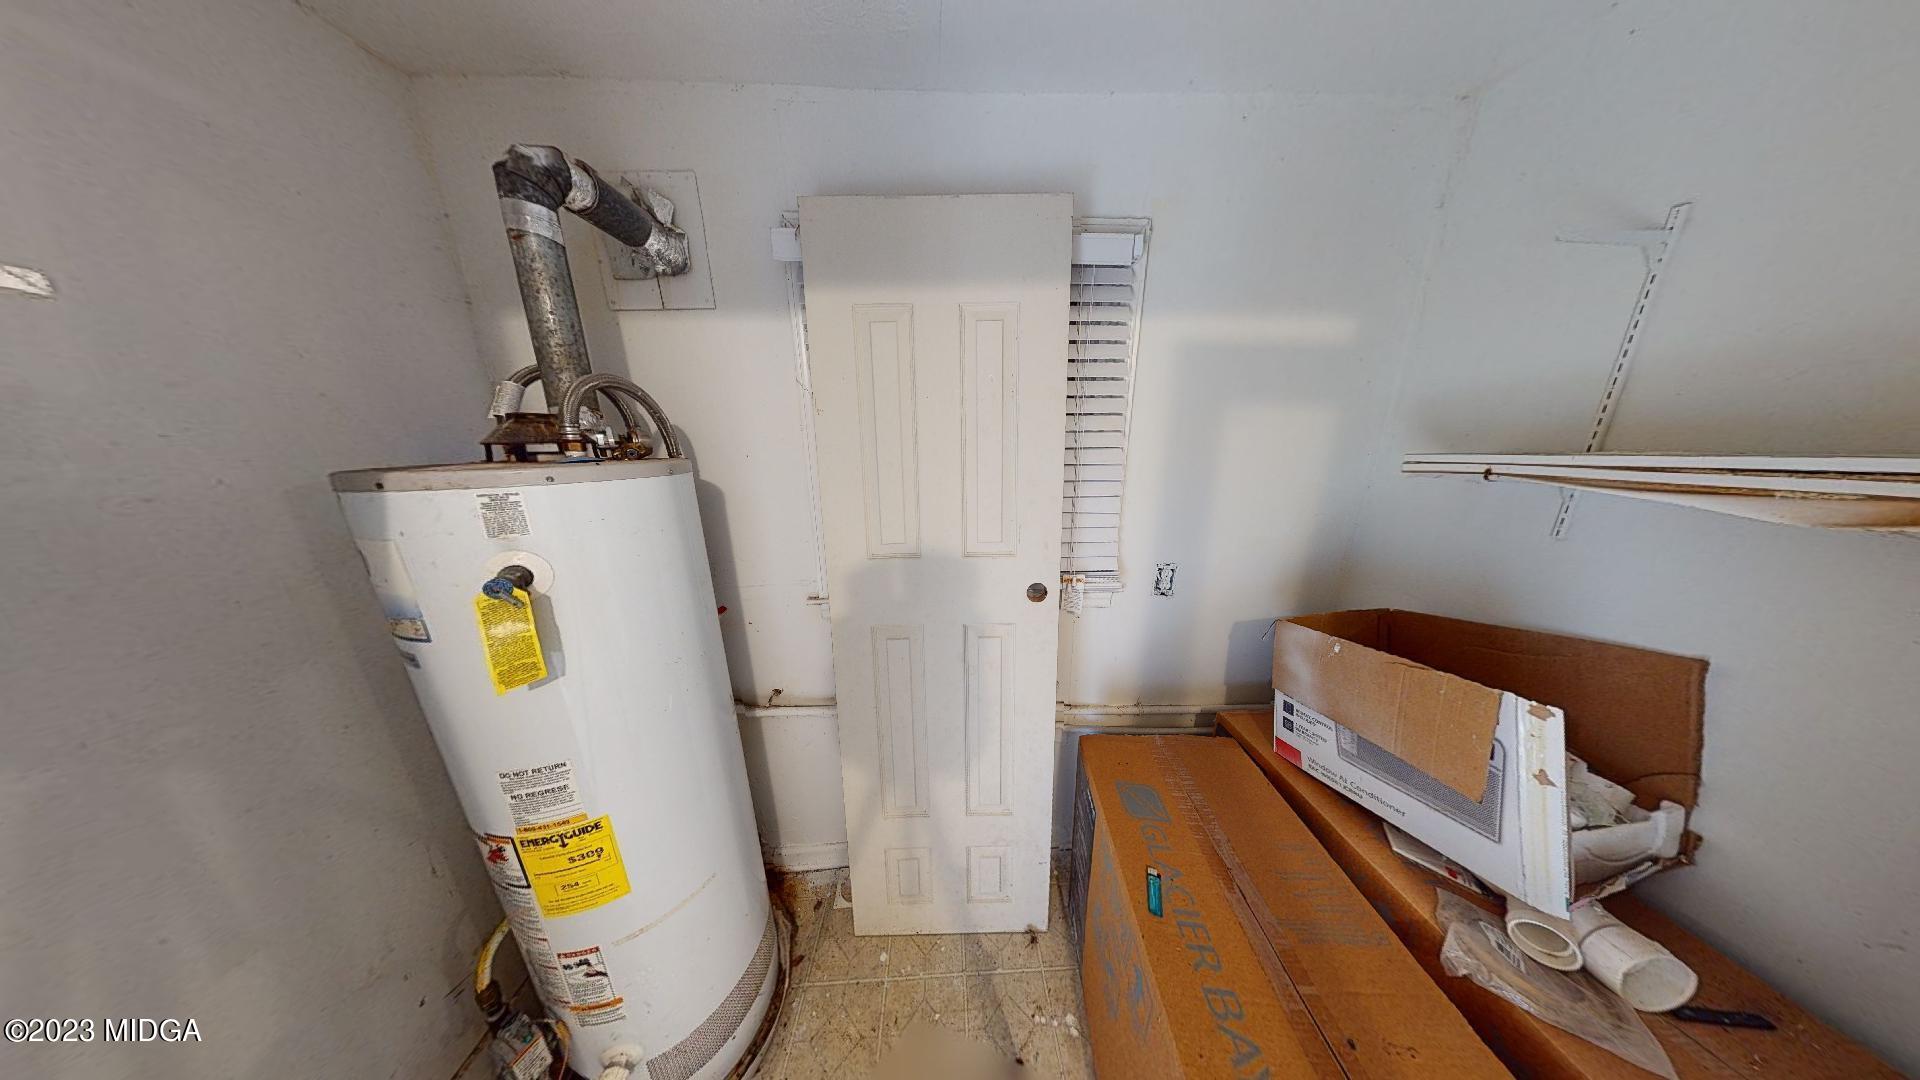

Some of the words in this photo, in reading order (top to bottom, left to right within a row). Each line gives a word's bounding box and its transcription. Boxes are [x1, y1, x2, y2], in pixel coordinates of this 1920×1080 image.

[512, 769, 529, 778] NOT
[530, 761, 568, 775] RETURN
[510, 793, 523, 801] NO
[1350, 781, 1406, 816] Conditioner
[1139, 822, 1223, 973] GLACIER
[1202, 985, 1273, 1080] BA
